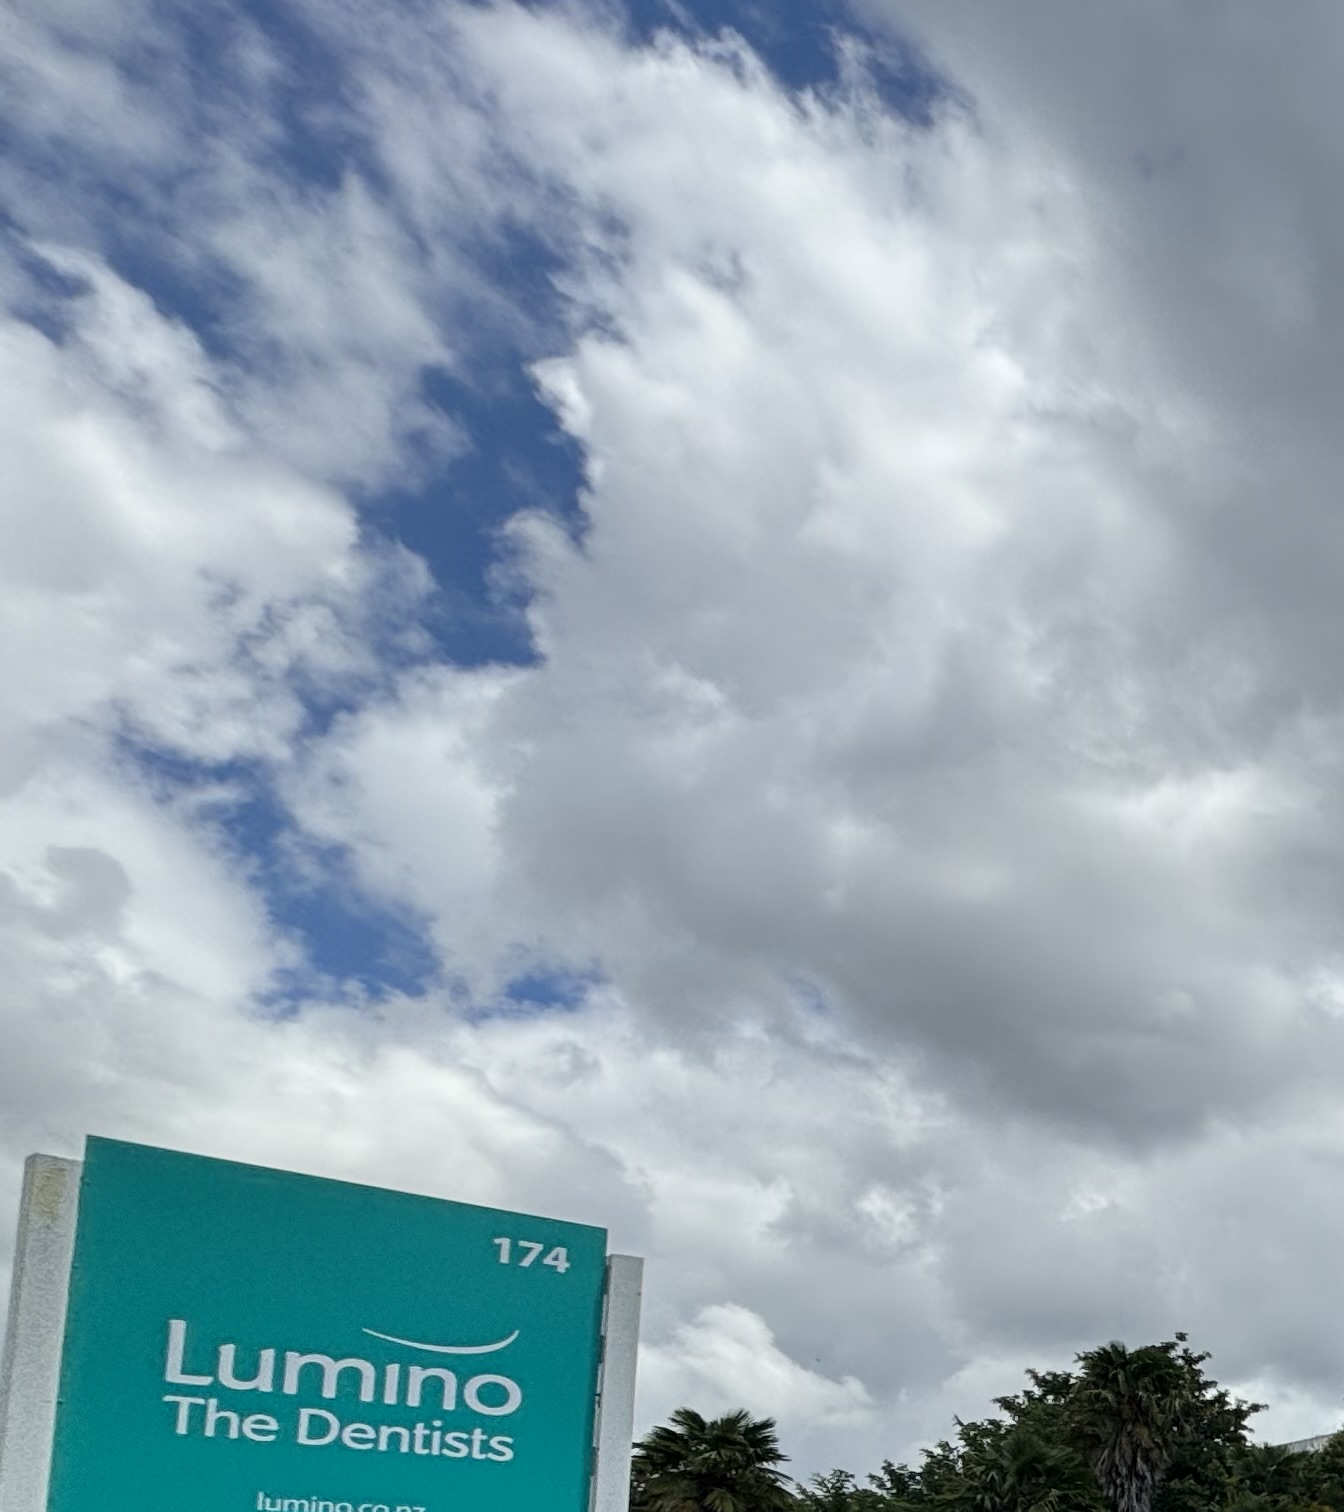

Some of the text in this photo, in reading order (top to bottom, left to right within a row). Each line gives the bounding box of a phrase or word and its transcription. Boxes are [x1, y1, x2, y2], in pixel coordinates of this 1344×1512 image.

[493, 1237, 571, 1274] 174
[164, 1319, 522, 1416] Lumino
[163, 1395, 515, 1462] The Dentists
